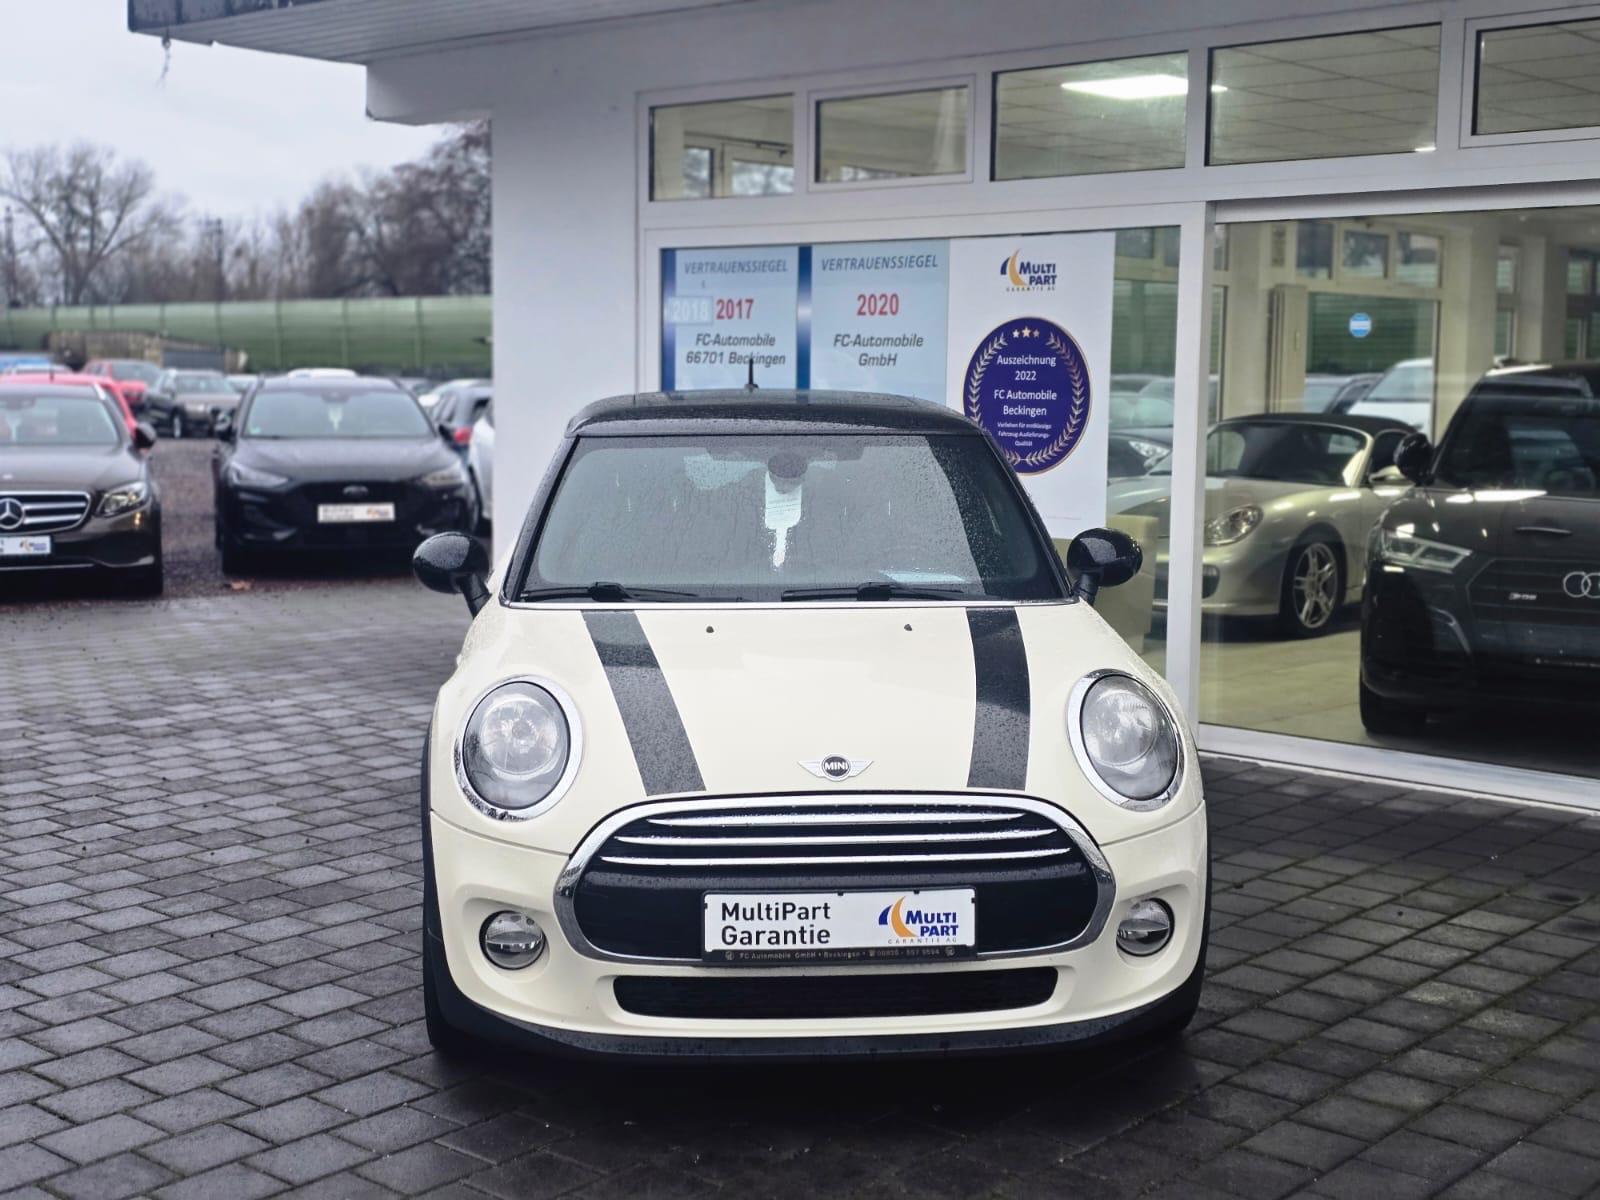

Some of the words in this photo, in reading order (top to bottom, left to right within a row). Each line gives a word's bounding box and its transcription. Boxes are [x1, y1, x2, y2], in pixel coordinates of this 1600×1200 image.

[684, 259, 788, 274] VERTRAUENSSIEGEL
[821, 254, 938, 271] VERTRAUENSSIEGEL
[1019, 261, 1056, 274] MULTI
[1029, 275, 1057, 285] PART
[716, 298, 754, 320] 2017
[856, 293, 899, 316] 2020
[695, 333, 776, 347] FC-Automobile
[833, 333, 924, 347] FC-Automobile
[686, 352, 723, 364] 66701
[728, 352, 786, 368] Beckingen
[858, 353, 898, 367] GmbH
[997, 355, 1056, 367] Auszeichnung
[1015, 370, 1037, 381] 2022
[994, 389, 1004, 400] FC
[1006, 389, 1057, 401] Automobile
[1003, 405, 1047, 416] Beckingen
[824, 761, 849, 771] MINI
[721, 902, 831, 921] MultiPart
[905, 910, 957, 924] MULTI
[721, 924, 831, 946] Garantie
[920, 925, 959, 937] PART
